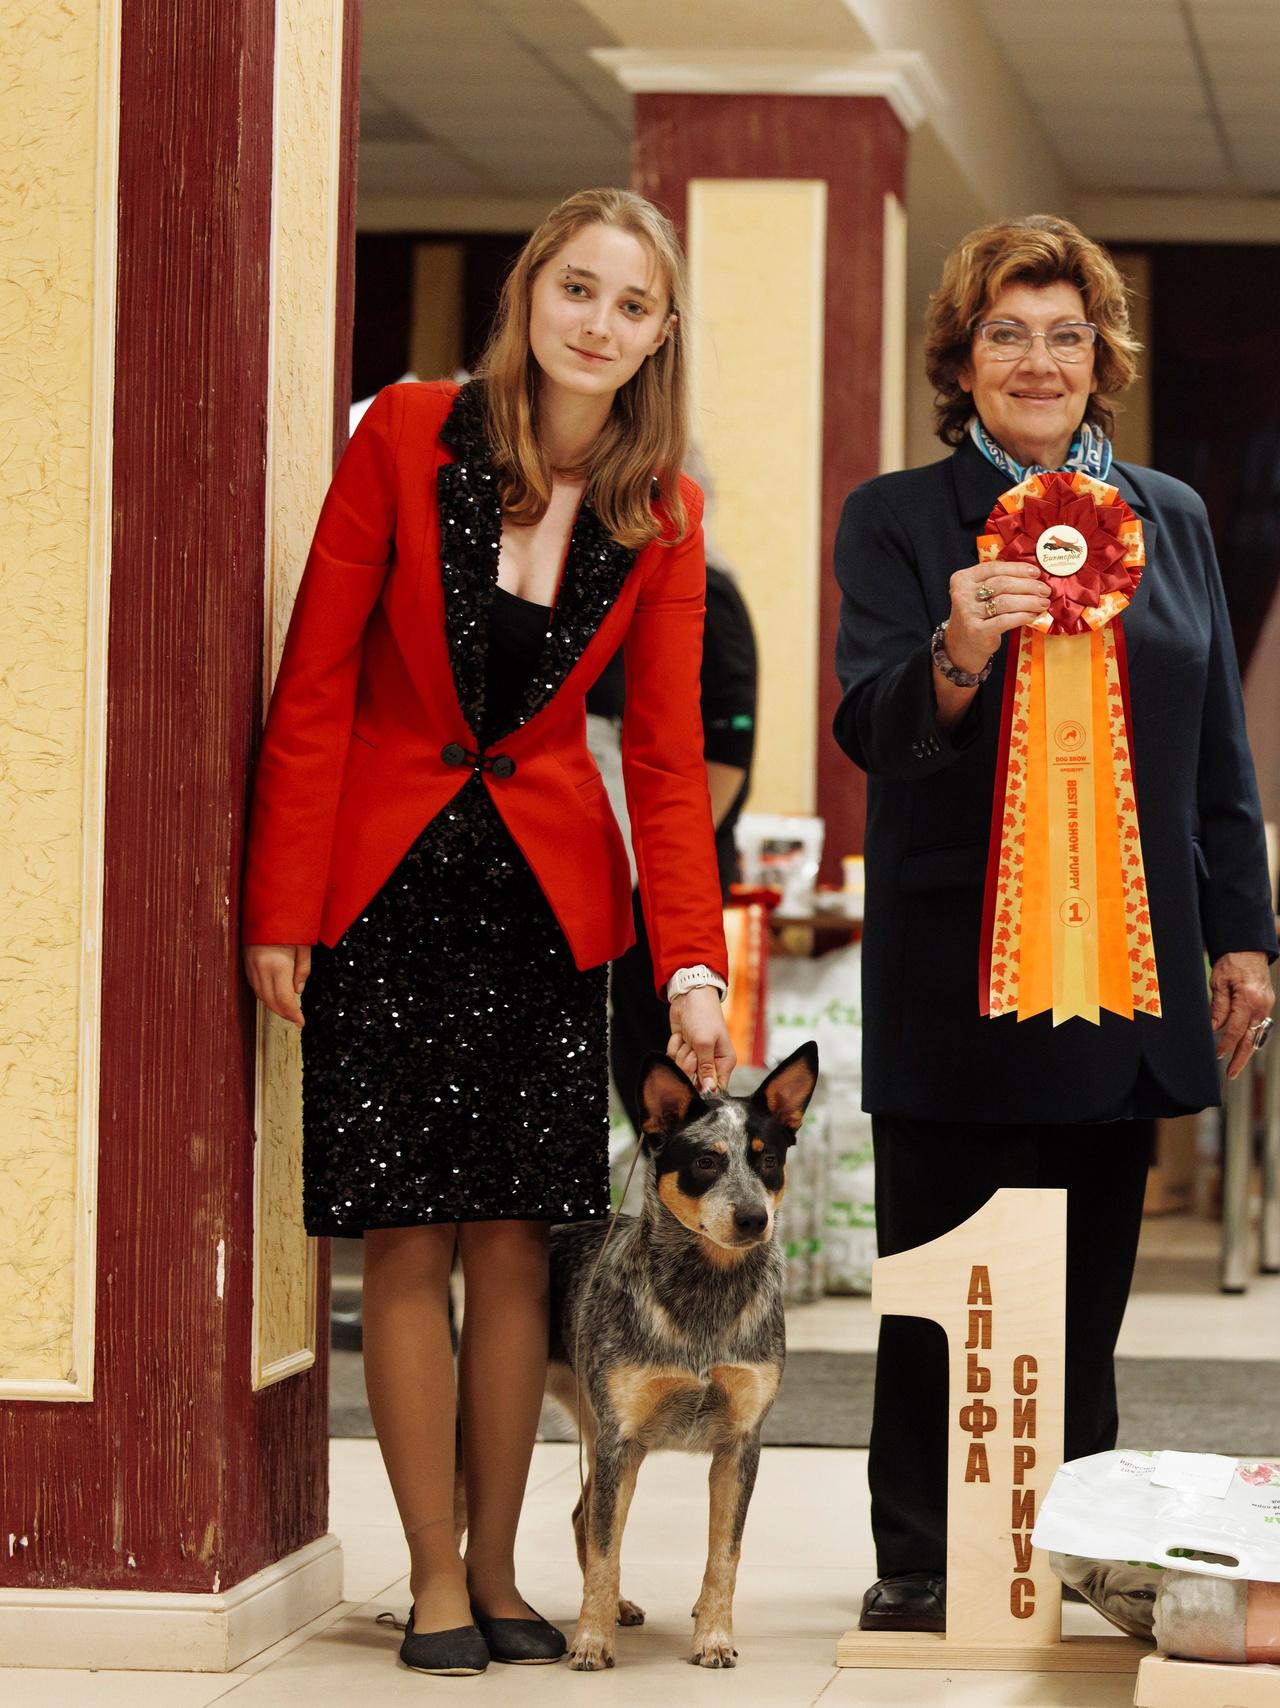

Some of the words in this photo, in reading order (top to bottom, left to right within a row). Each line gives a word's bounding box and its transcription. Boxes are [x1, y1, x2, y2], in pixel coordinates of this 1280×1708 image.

[1043, 554, 1081, 563] Виктория
[1067, 780, 1078, 805] BEST
[1068, 808, 1078, 819] IN
[1068, 821, 1079, 853] SHOW
[1069, 856, 1080, 890] PUPPY
[1068, 902, 1083, 922] 1
[959, 1265, 998, 1483] АЛЬФА
[1009, 1354, 1039, 1620] СИРИУС
